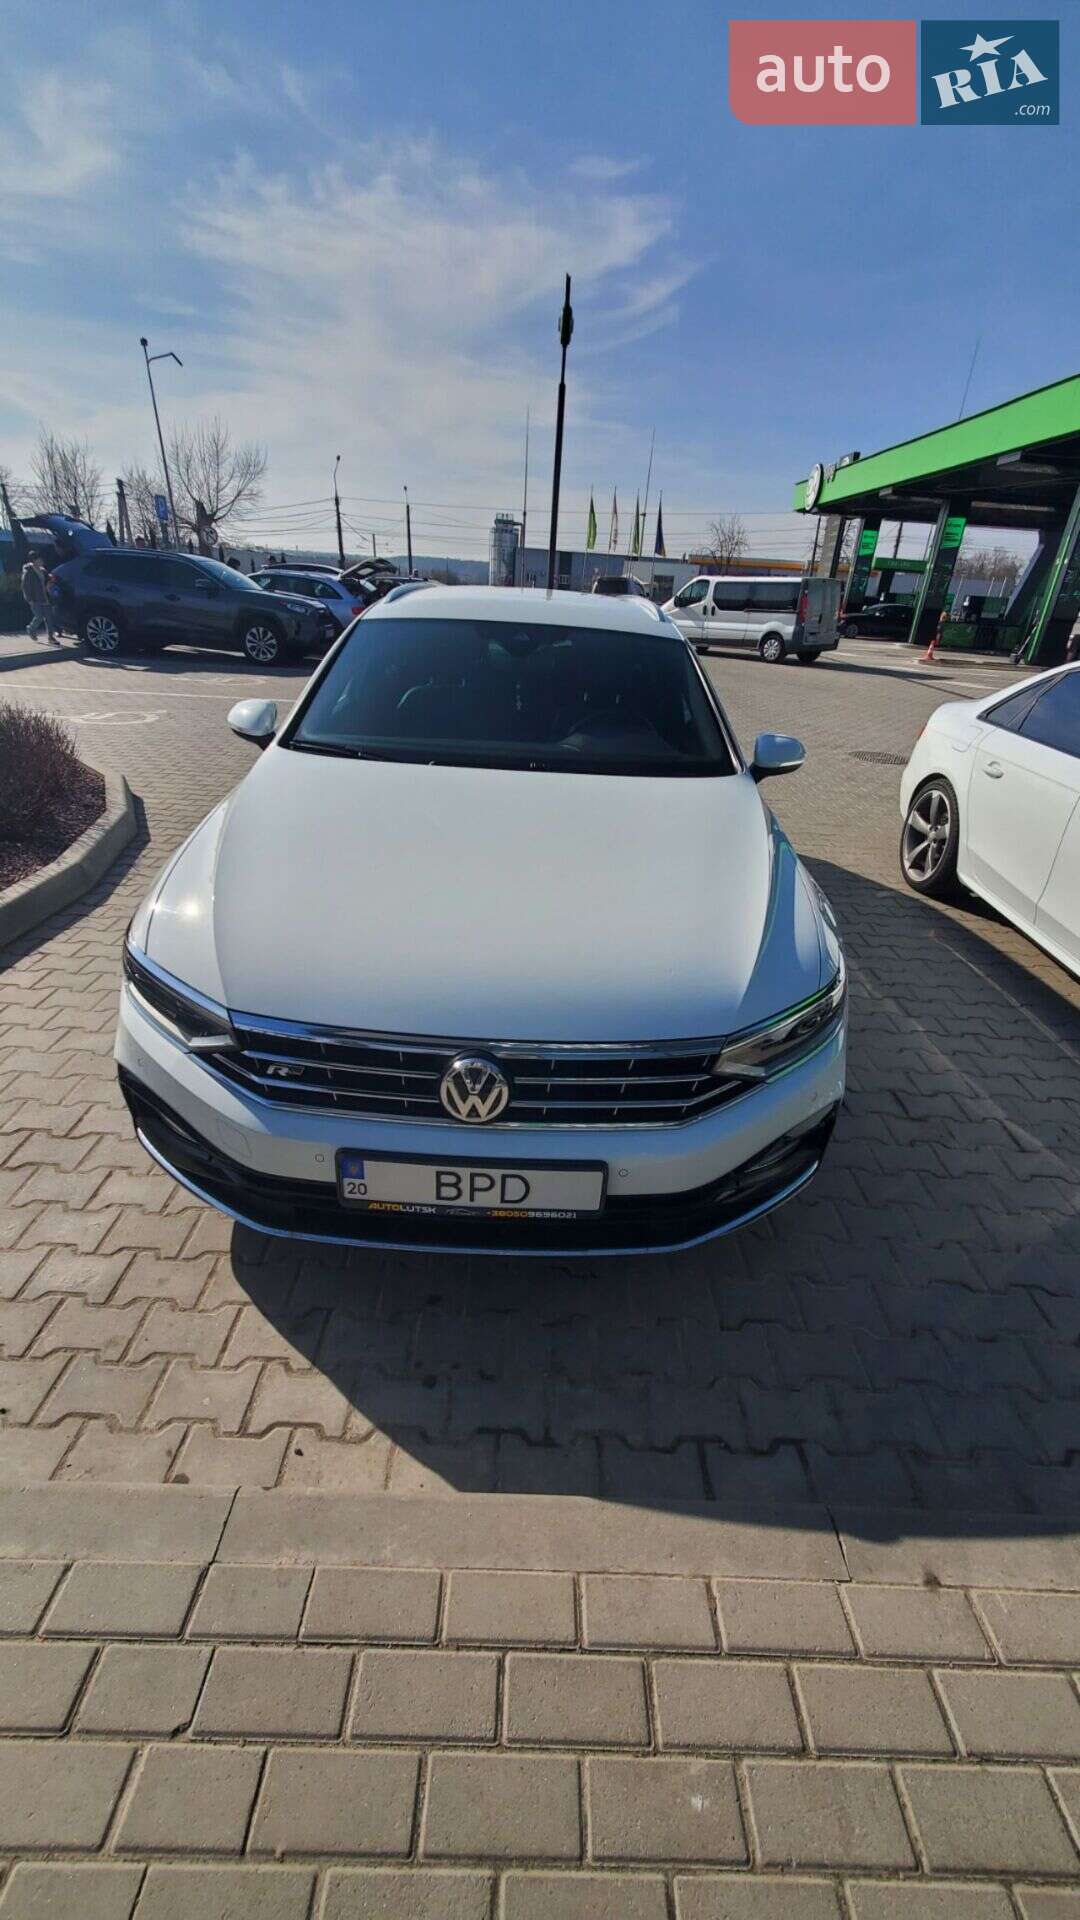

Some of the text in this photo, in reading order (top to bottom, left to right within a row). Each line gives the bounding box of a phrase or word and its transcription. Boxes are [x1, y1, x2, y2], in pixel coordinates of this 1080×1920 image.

[347, 1182, 368, 1196] 20
[435, 1170, 531, 1204] BPD
[368, 1202, 437, 1214] AUTOLUTSK
